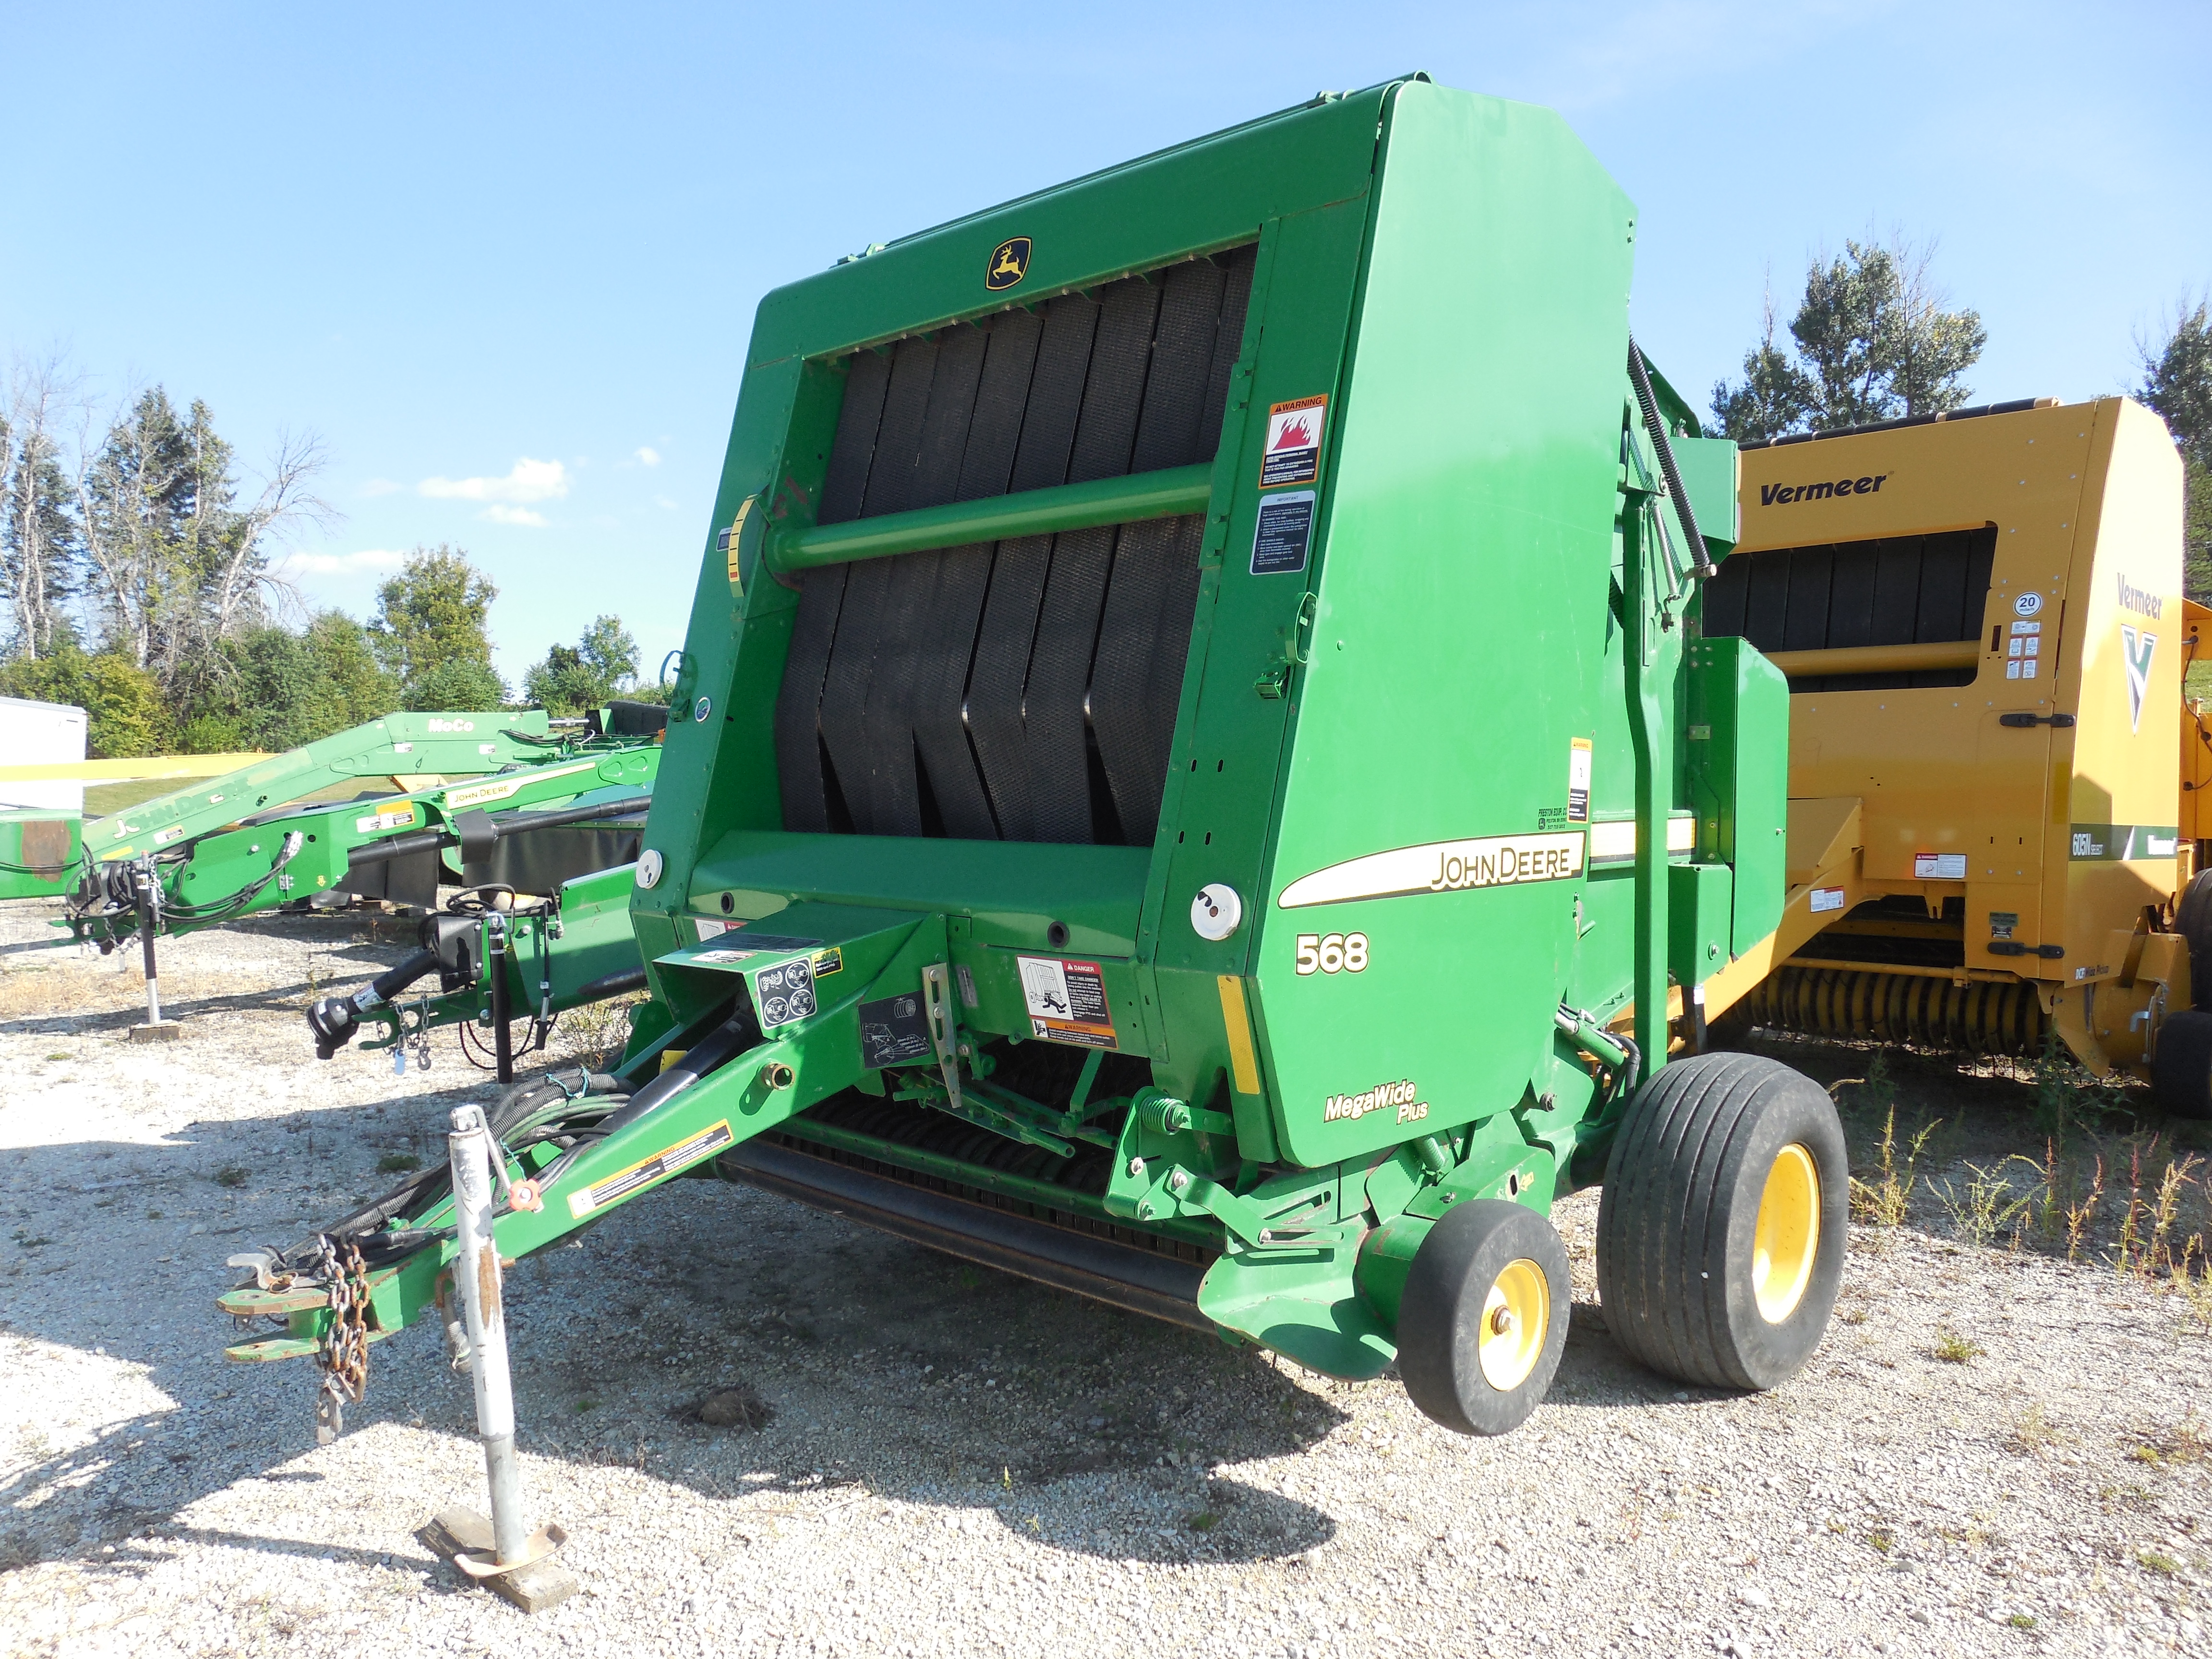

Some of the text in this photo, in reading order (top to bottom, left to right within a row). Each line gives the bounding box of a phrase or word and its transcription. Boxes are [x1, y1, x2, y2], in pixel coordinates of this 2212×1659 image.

[1283, 397, 1322, 410] WARNING
[1761, 475, 1887, 506] Vermeer
[2019, 597, 2035, 608] 20
[2117, 572, 2162, 621] Vermeer
[427, 717, 474, 733] MoCo
[454, 786, 509, 802] JOHN DEERE
[2072, 833, 2091, 856] 605N
[1431, 847, 1570, 886] JOHN DEERE
[1296, 931, 1369, 976] 568
[1323, 1078, 1416, 1123] MegaWide
[1396, 1102, 1429, 1126] Plus
[649, 1147, 675, 1162] WARNING
